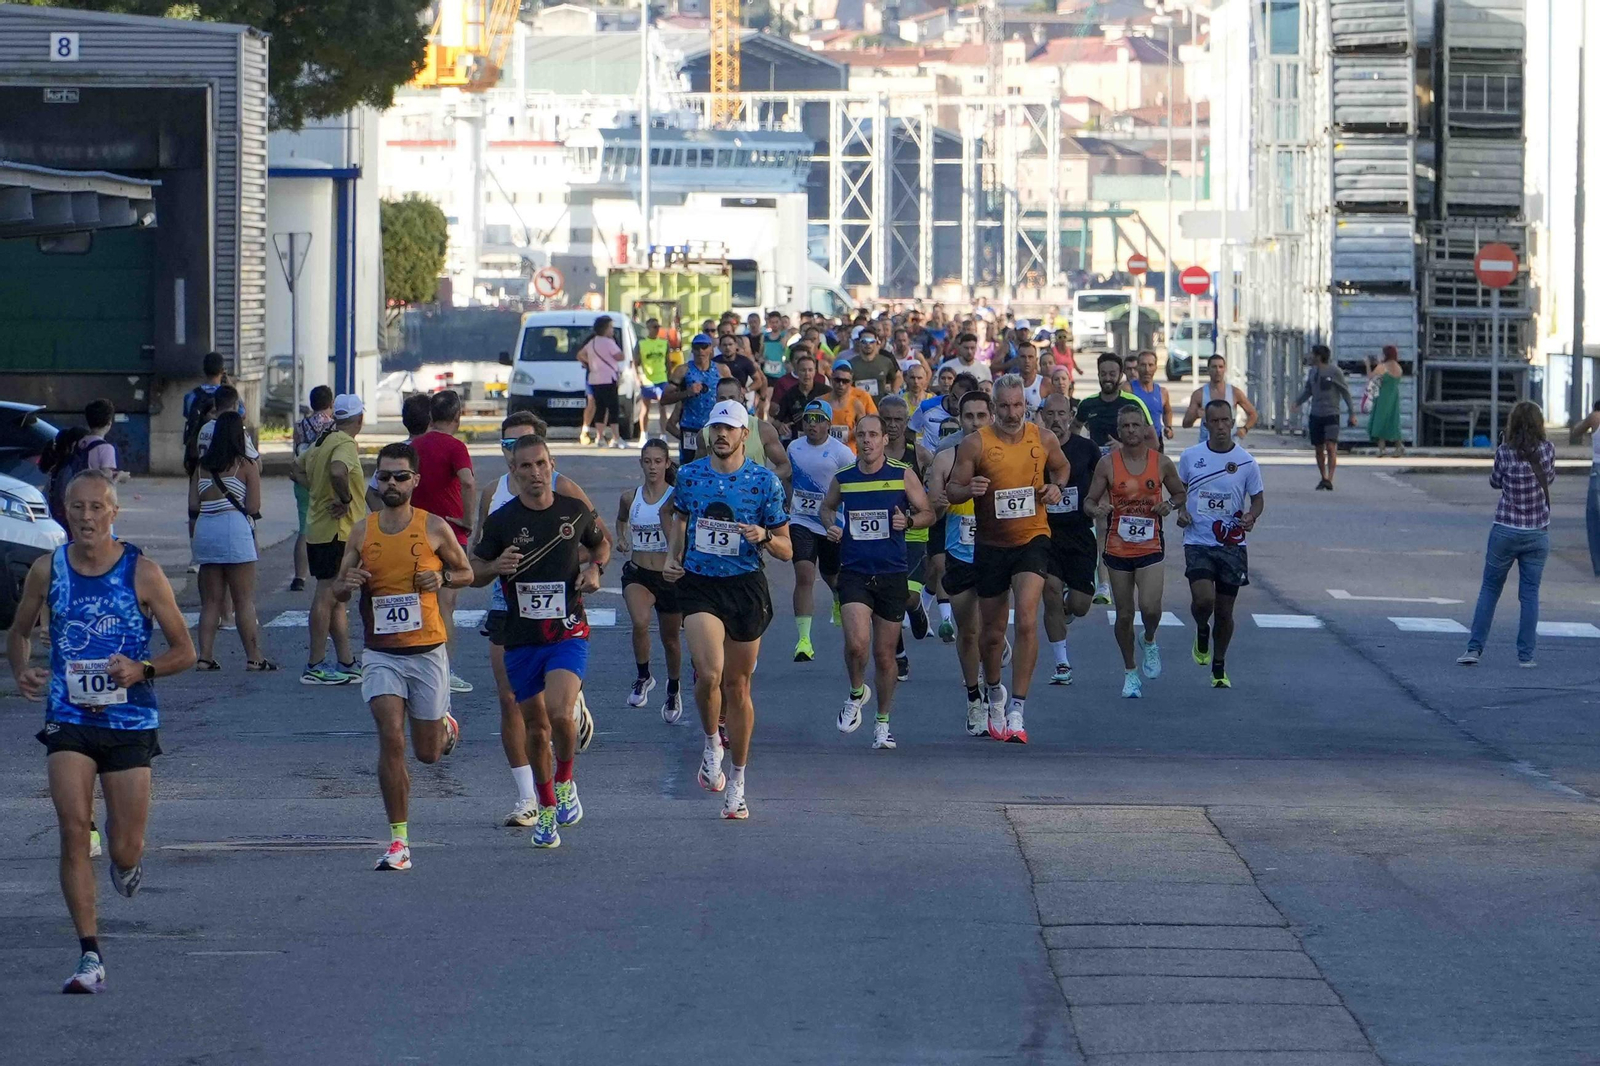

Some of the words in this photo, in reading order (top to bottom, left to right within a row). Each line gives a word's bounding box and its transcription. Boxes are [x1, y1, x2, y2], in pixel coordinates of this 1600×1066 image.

[58, 37, 70, 57] 8
[801, 498, 816, 509] 22
[1008, 498, 1026, 510] 67
[1208, 499, 1224, 509] 64
[861, 520, 879, 532] 50
[1129, 525, 1146, 536] 84
[638, 531, 660, 543] 171
[708, 531, 729, 546] 13
[531, 595, 554, 609] 57
[386, 607, 409, 622] 40
[78, 675, 119, 693] 105
